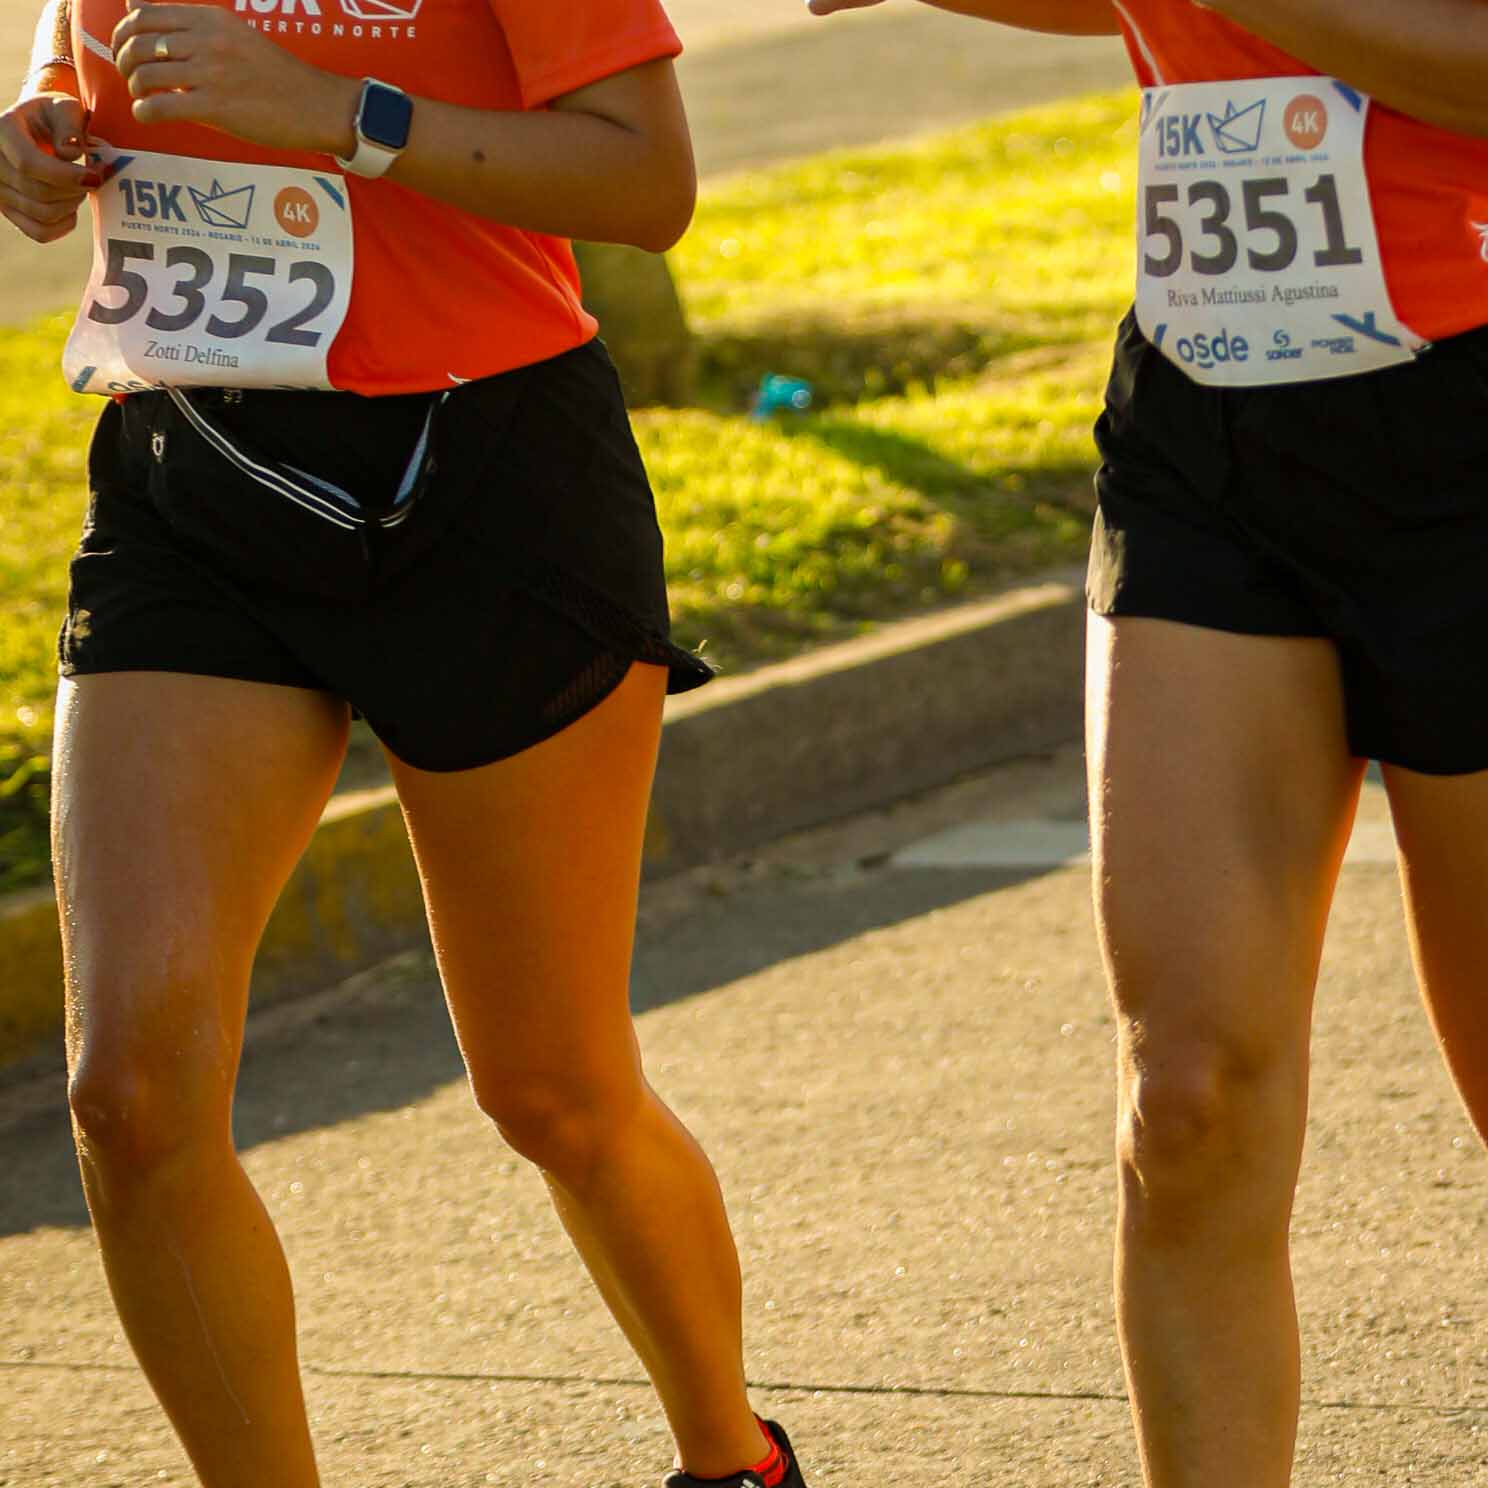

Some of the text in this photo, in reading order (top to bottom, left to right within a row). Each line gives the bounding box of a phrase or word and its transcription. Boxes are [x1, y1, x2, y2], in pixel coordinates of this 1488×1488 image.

[332, 24, 417, 38] NORTE
[1155, 112, 1206, 158] 15K
[1291, 115, 1319, 134] 4K
[118, 178, 187, 223] 15K
[282, 202, 312, 224] 4K
[1144, 173, 1363, 278] 5351
[87, 238, 336, 348] 5352
[1167, 280, 1339, 308] Riva Mattiussi Agustina
[143, 340, 240, 369] Zotti Delfina
[1176, 328, 1249, 363] osde
